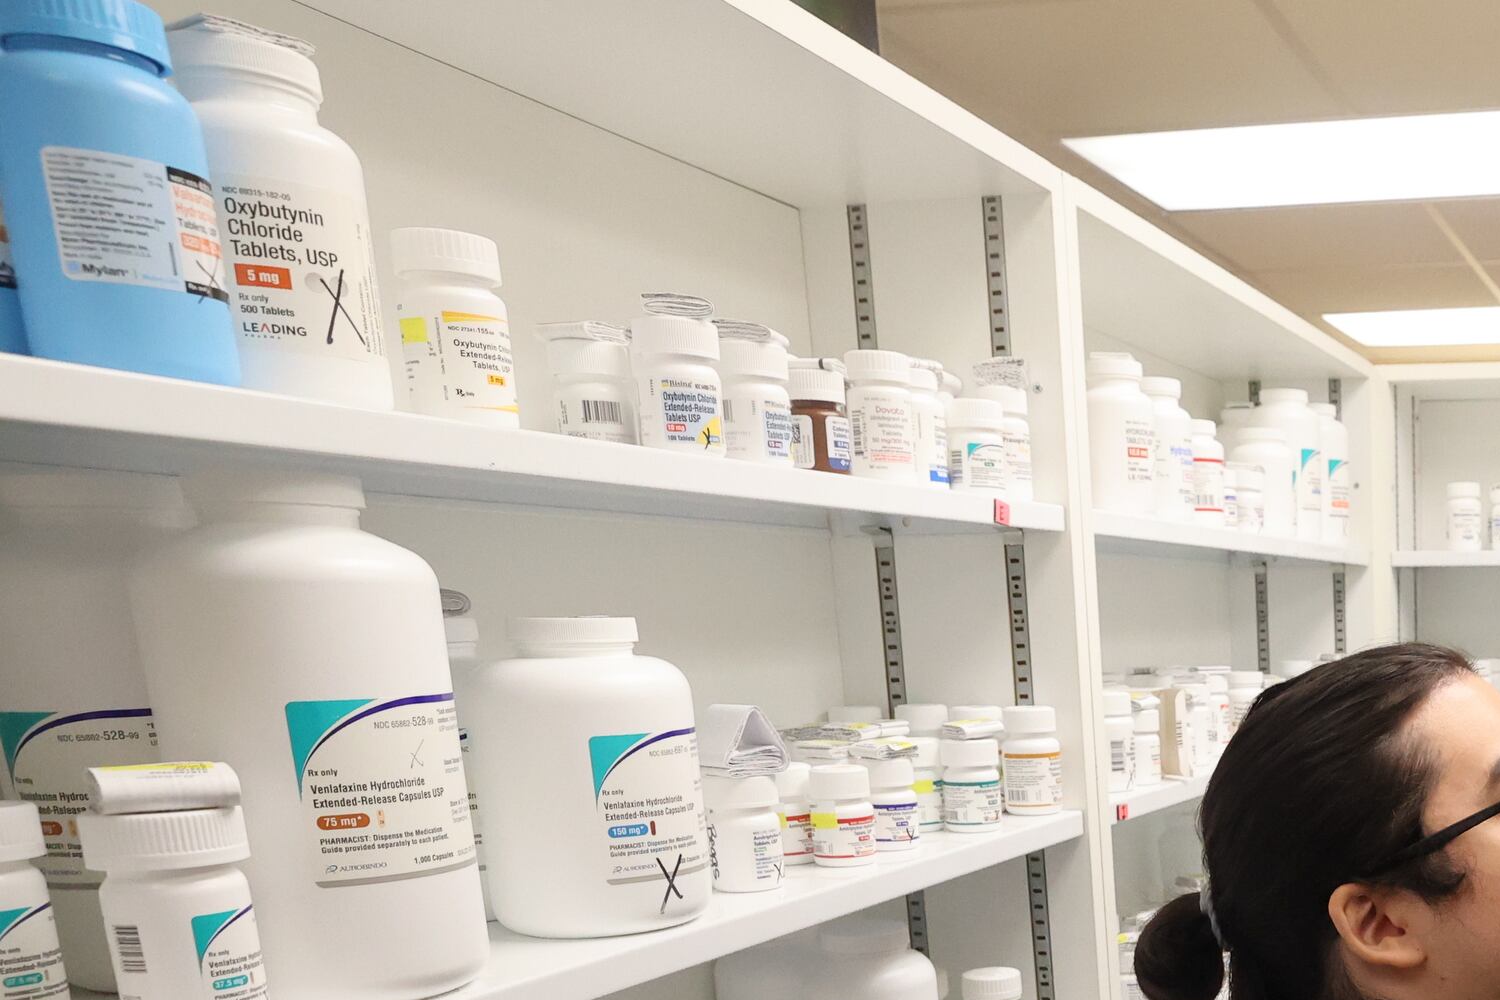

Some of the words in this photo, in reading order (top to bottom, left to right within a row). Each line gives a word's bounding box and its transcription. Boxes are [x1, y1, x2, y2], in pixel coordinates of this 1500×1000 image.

[225, 198, 324, 227] Oxybutynin
[228, 219, 303, 242] Chloride
[230, 240, 302, 265] Tablets,
[306, 249, 338, 268] USP
[247, 270, 256, 281] 5
[259, 272, 280, 285] mg
[241, 305, 258, 314] 500
[261, 306, 295, 318] Tablets
[243, 322, 307, 336] LEADING
[454, 339, 497, 352] Oxybutynin
[663, 392, 696, 402] Oxybutynin
[664, 403, 715, 414] Extended-Release
[665, 413, 687, 422] Tablets
[689, 414, 701, 423] USP
[374, 721, 389, 729] NDC
[308, 769, 319, 777] Rx
[321, 769, 338, 777] only
[311, 784, 368, 795] Venlafaxine
[370, 777, 425, 792] Hydrochloride
[313, 795, 397, 809] Extended-Release
[399, 791, 431, 802] Capsules
[432, 788, 444, 798] USP
[604, 800, 645, 811] Venlafaxine
[646, 795, 683, 807] Hydrochloride
[606, 810, 665, 822] Extended-Release
[665, 806, 687, 816] Capsules
[324, 817, 337, 826] 75
[320, 835, 371, 846] PHARMACIST:
[373, 833, 402, 842] Dispense
[404, 830, 414, 838] the
[415, 827, 443, 838] Medication
[613, 828, 627, 836] 150
[322, 846, 343, 854] Guide
[345, 843, 376, 853] provided
[378, 839, 411, 850] separately
[627, 848, 649, 857] provided
[414, 856, 431, 864] 1,000
[432, 852, 454, 863] Capsules
[209, 955, 248, 968] Venlafaxine
